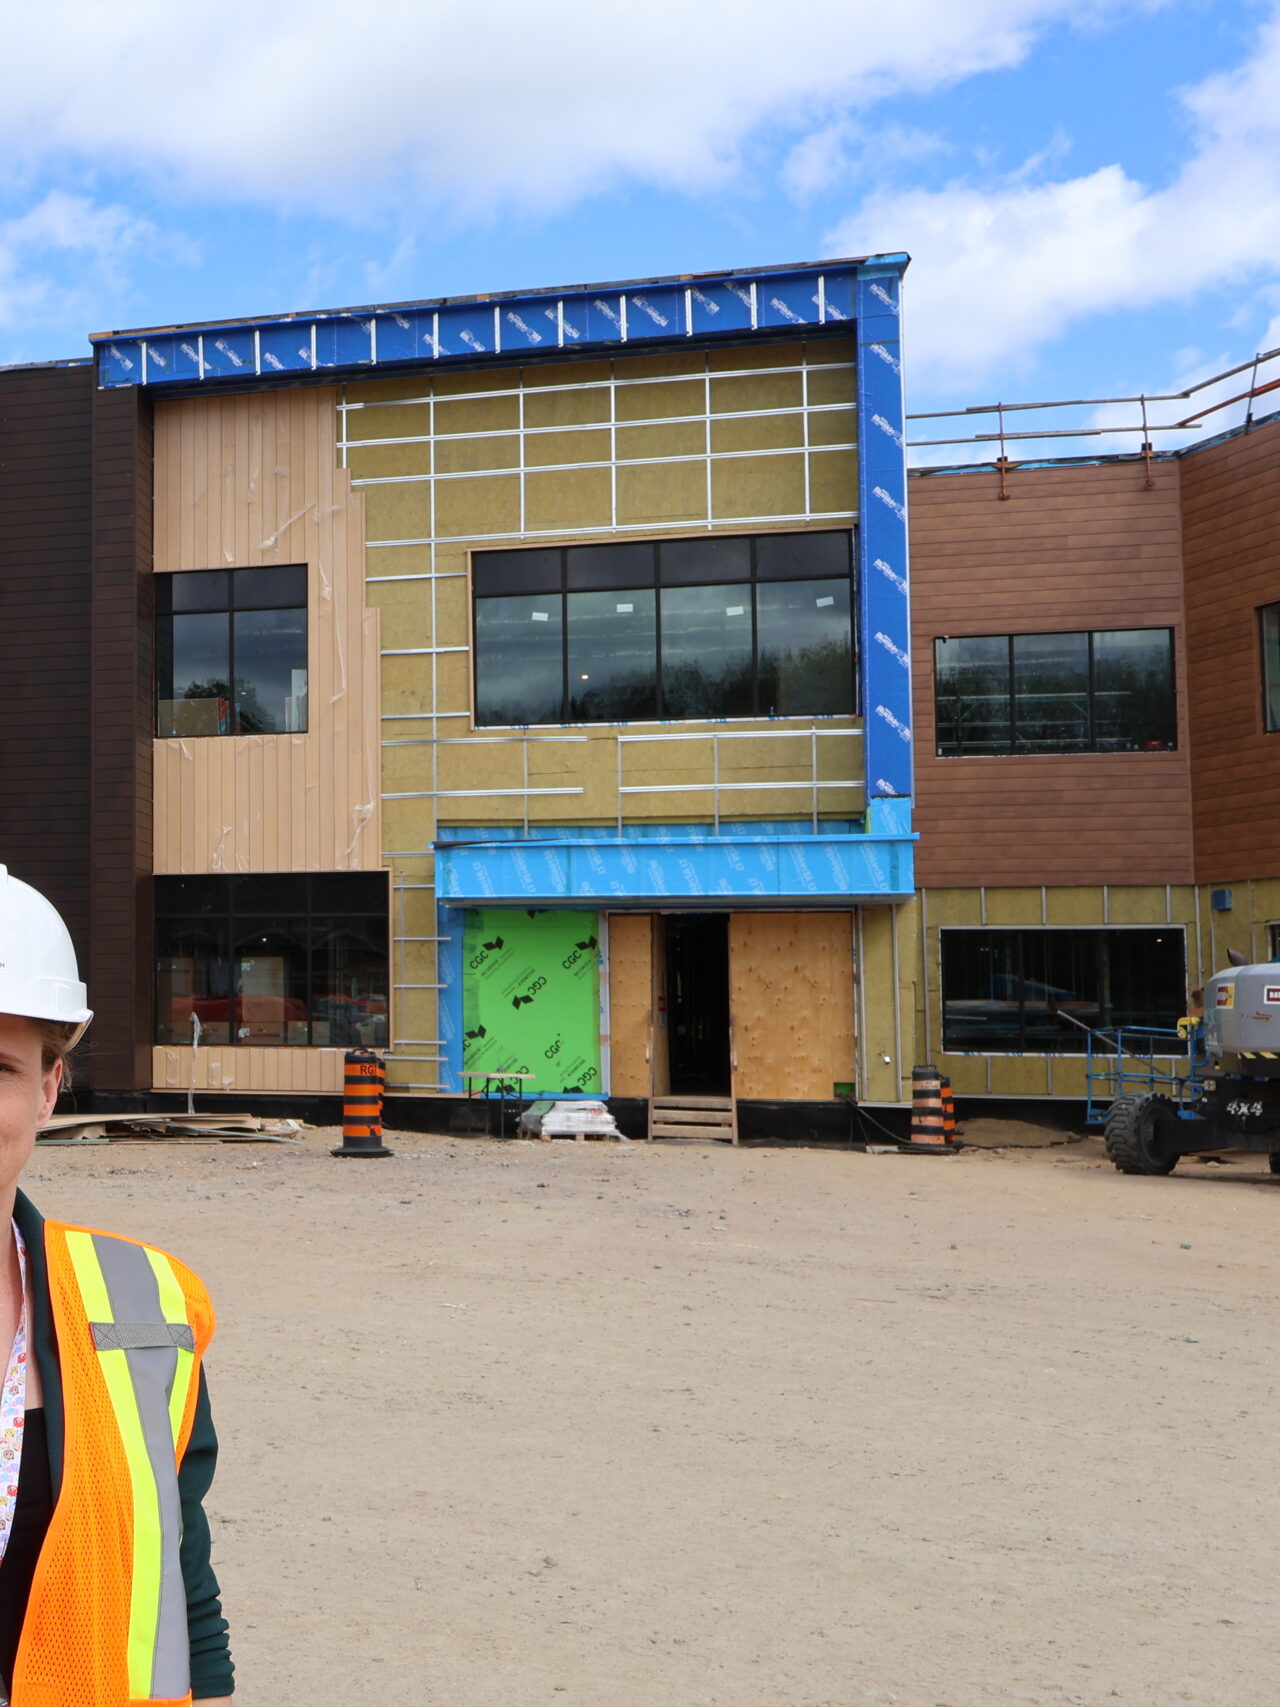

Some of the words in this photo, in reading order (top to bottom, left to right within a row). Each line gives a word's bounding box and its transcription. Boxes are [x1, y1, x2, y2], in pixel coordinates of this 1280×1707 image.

[469, 950, 489, 969] CGC
[562, 950, 582, 969] CGC
[527, 976, 547, 995] CGC
[509, 1065, 530, 1085] CC
[577, 1066, 598, 1086] CGC
